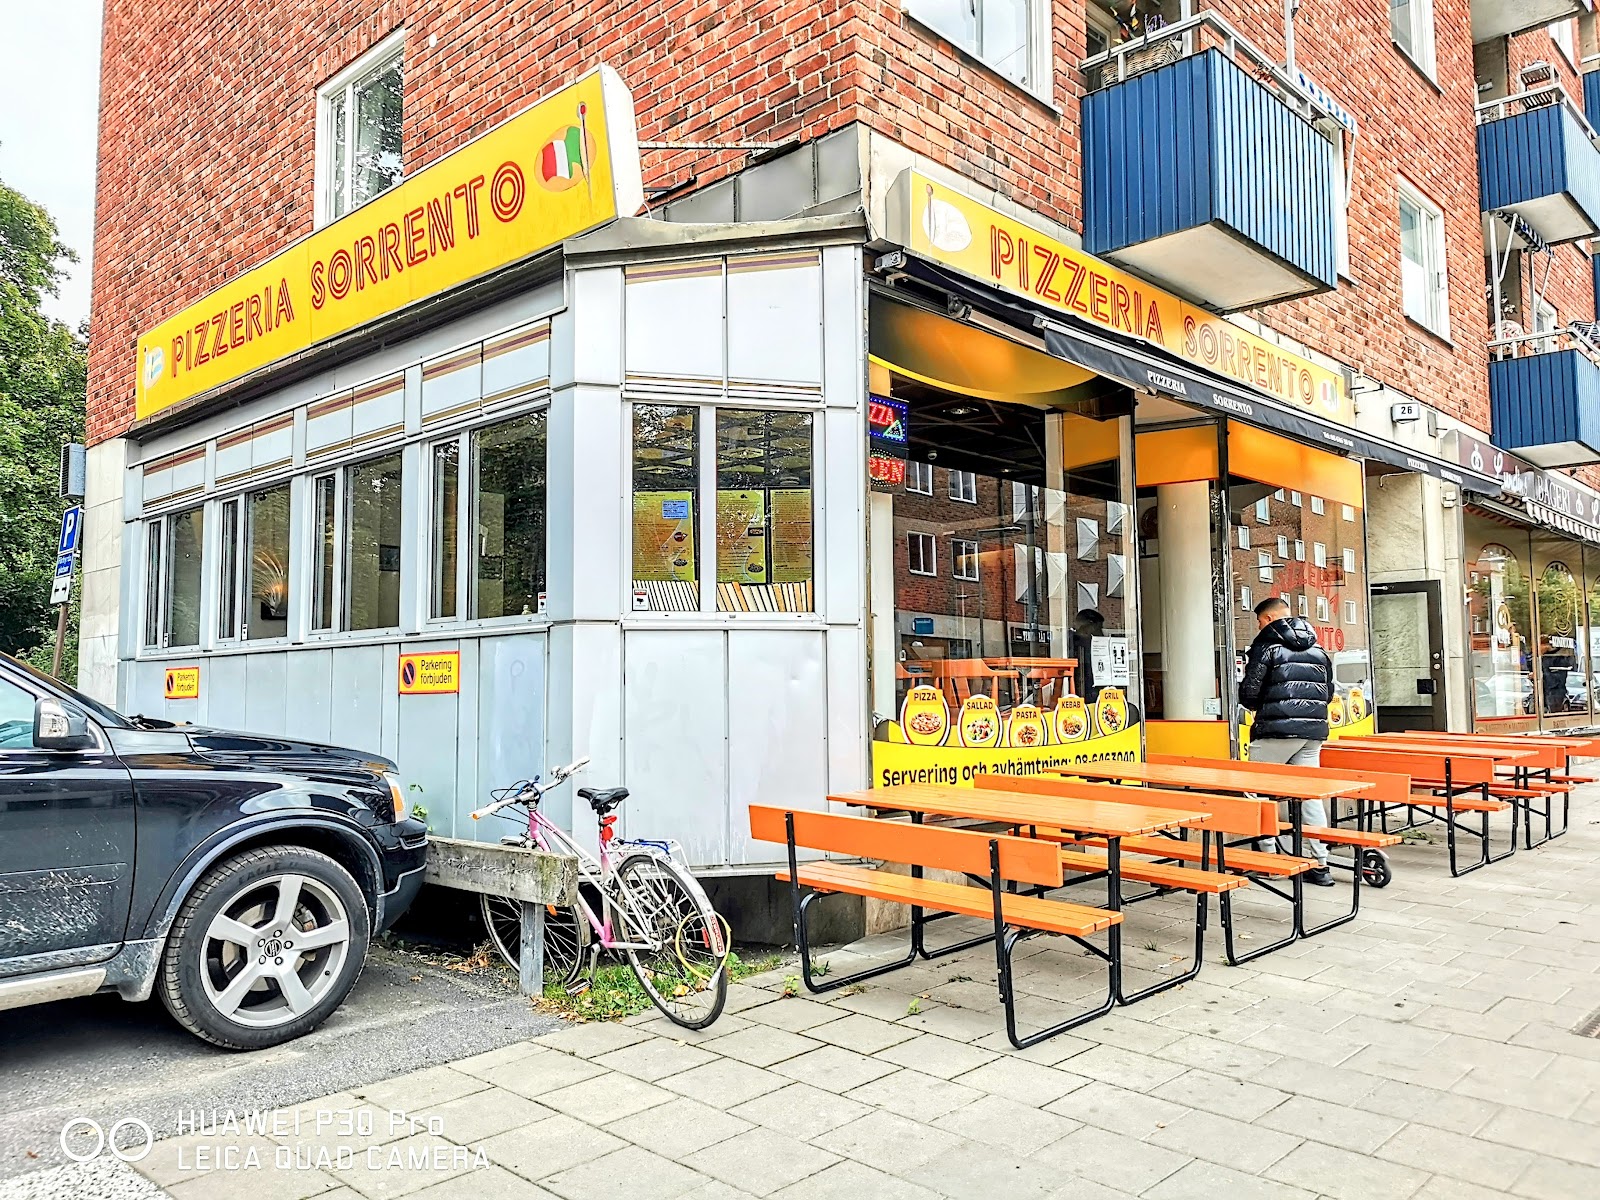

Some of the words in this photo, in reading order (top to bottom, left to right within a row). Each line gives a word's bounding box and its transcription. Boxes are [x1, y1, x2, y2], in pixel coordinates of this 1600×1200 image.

[172, 278, 294, 377] PIZZERIA
[311, 161, 525, 310] SORRENTO
[990, 225, 1165, 346] PIZZERIA
[1184, 315, 1314, 405] SORRENTO
[1147, 370, 1187, 395] PIZZERIA
[1213, 394, 1253, 416] SORRENTO
[1400, 405, 1412, 414] 26
[1537, 475, 1571, 514] BAGERI
[63, 513, 75, 547] P
[421, 659, 452, 673] Parkering
[177, 672, 195, 683] Parkering
[420, 673, 452, 687] förbjuden
[176, 682, 195, 692] förbjuden
[914, 692, 937, 702] PIZZA
[1104, 692, 1119, 700] GRILL
[966, 700, 994, 711] SALLAD
[1061, 700, 1081, 710] KEBAB
[1015, 710, 1038, 720] PASTA
[882, 762, 958, 788] Servering
